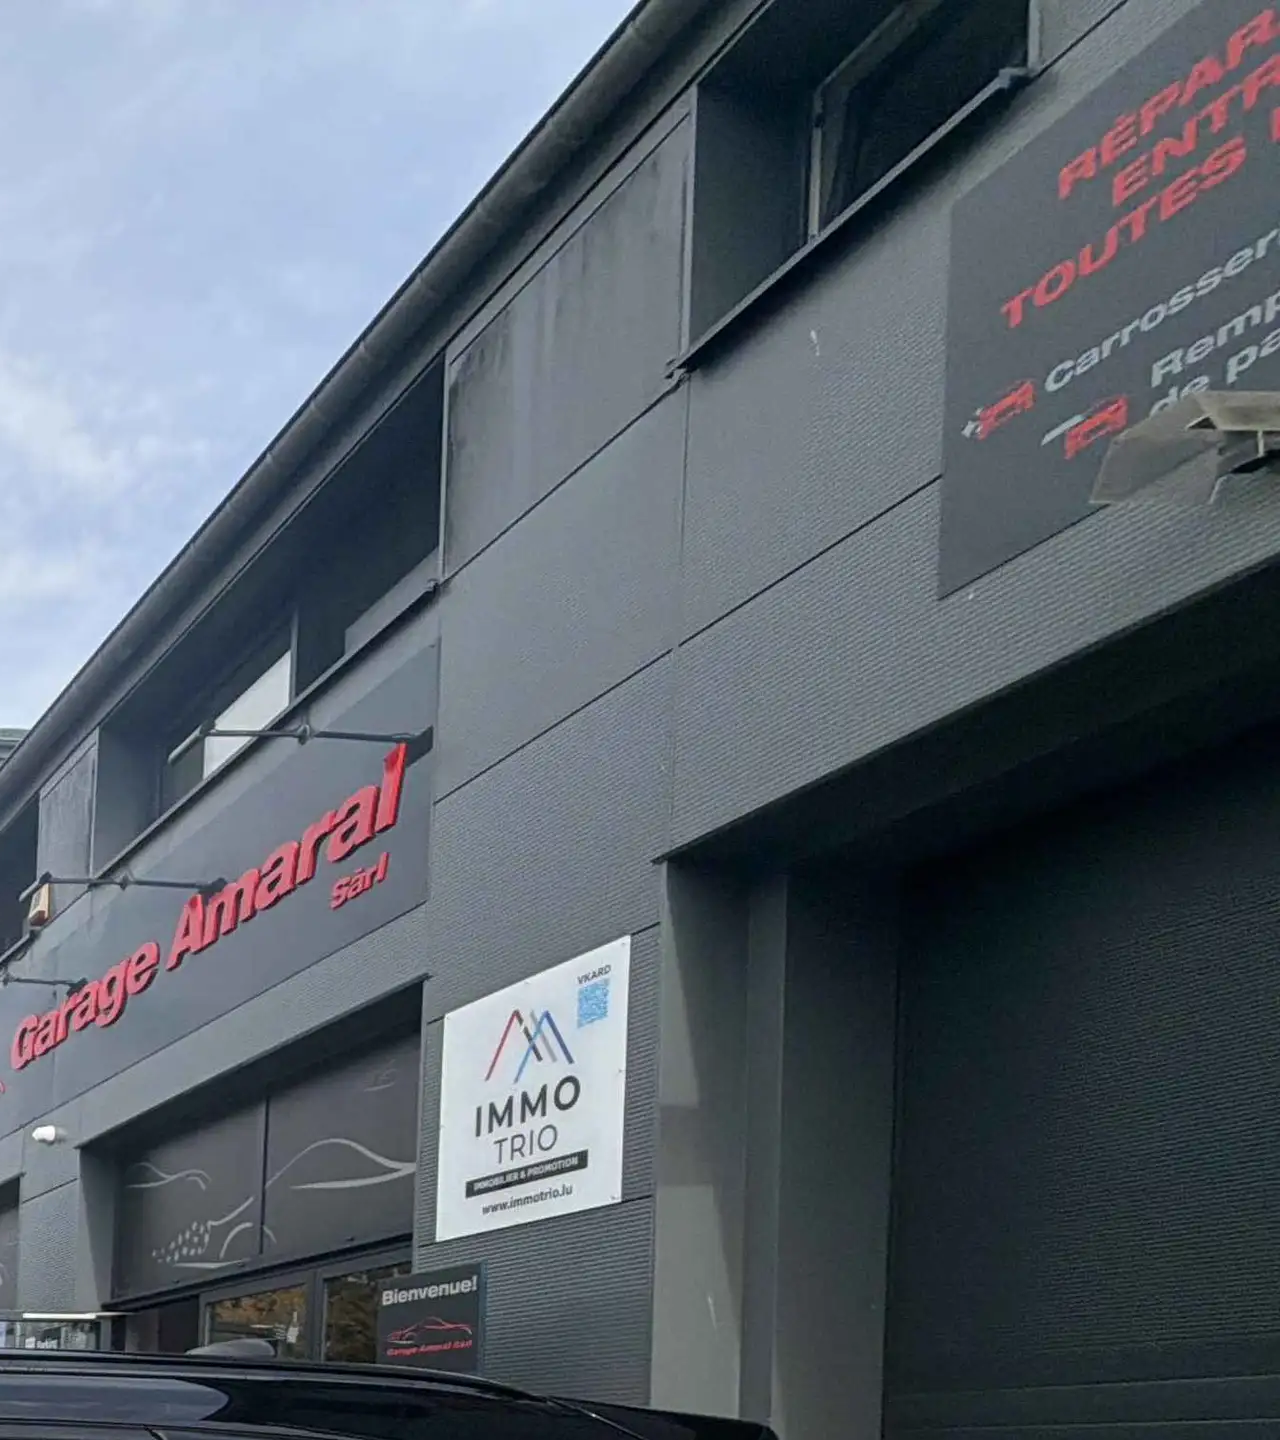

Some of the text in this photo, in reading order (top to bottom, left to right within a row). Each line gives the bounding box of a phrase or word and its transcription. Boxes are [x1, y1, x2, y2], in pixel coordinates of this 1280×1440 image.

[1000, 136, 1247, 329] TOUTES
[10, 742, 408, 1071] Garage Amaral
[577, 964, 611, 985] VKARD
[475, 1075, 581, 1138] IMMO
[493, 1124, 558, 1165] TRIO
[482, 1183, 574, 1215] www.immotrio.lu
[381, 1275, 478, 1306] Bienvenue!
